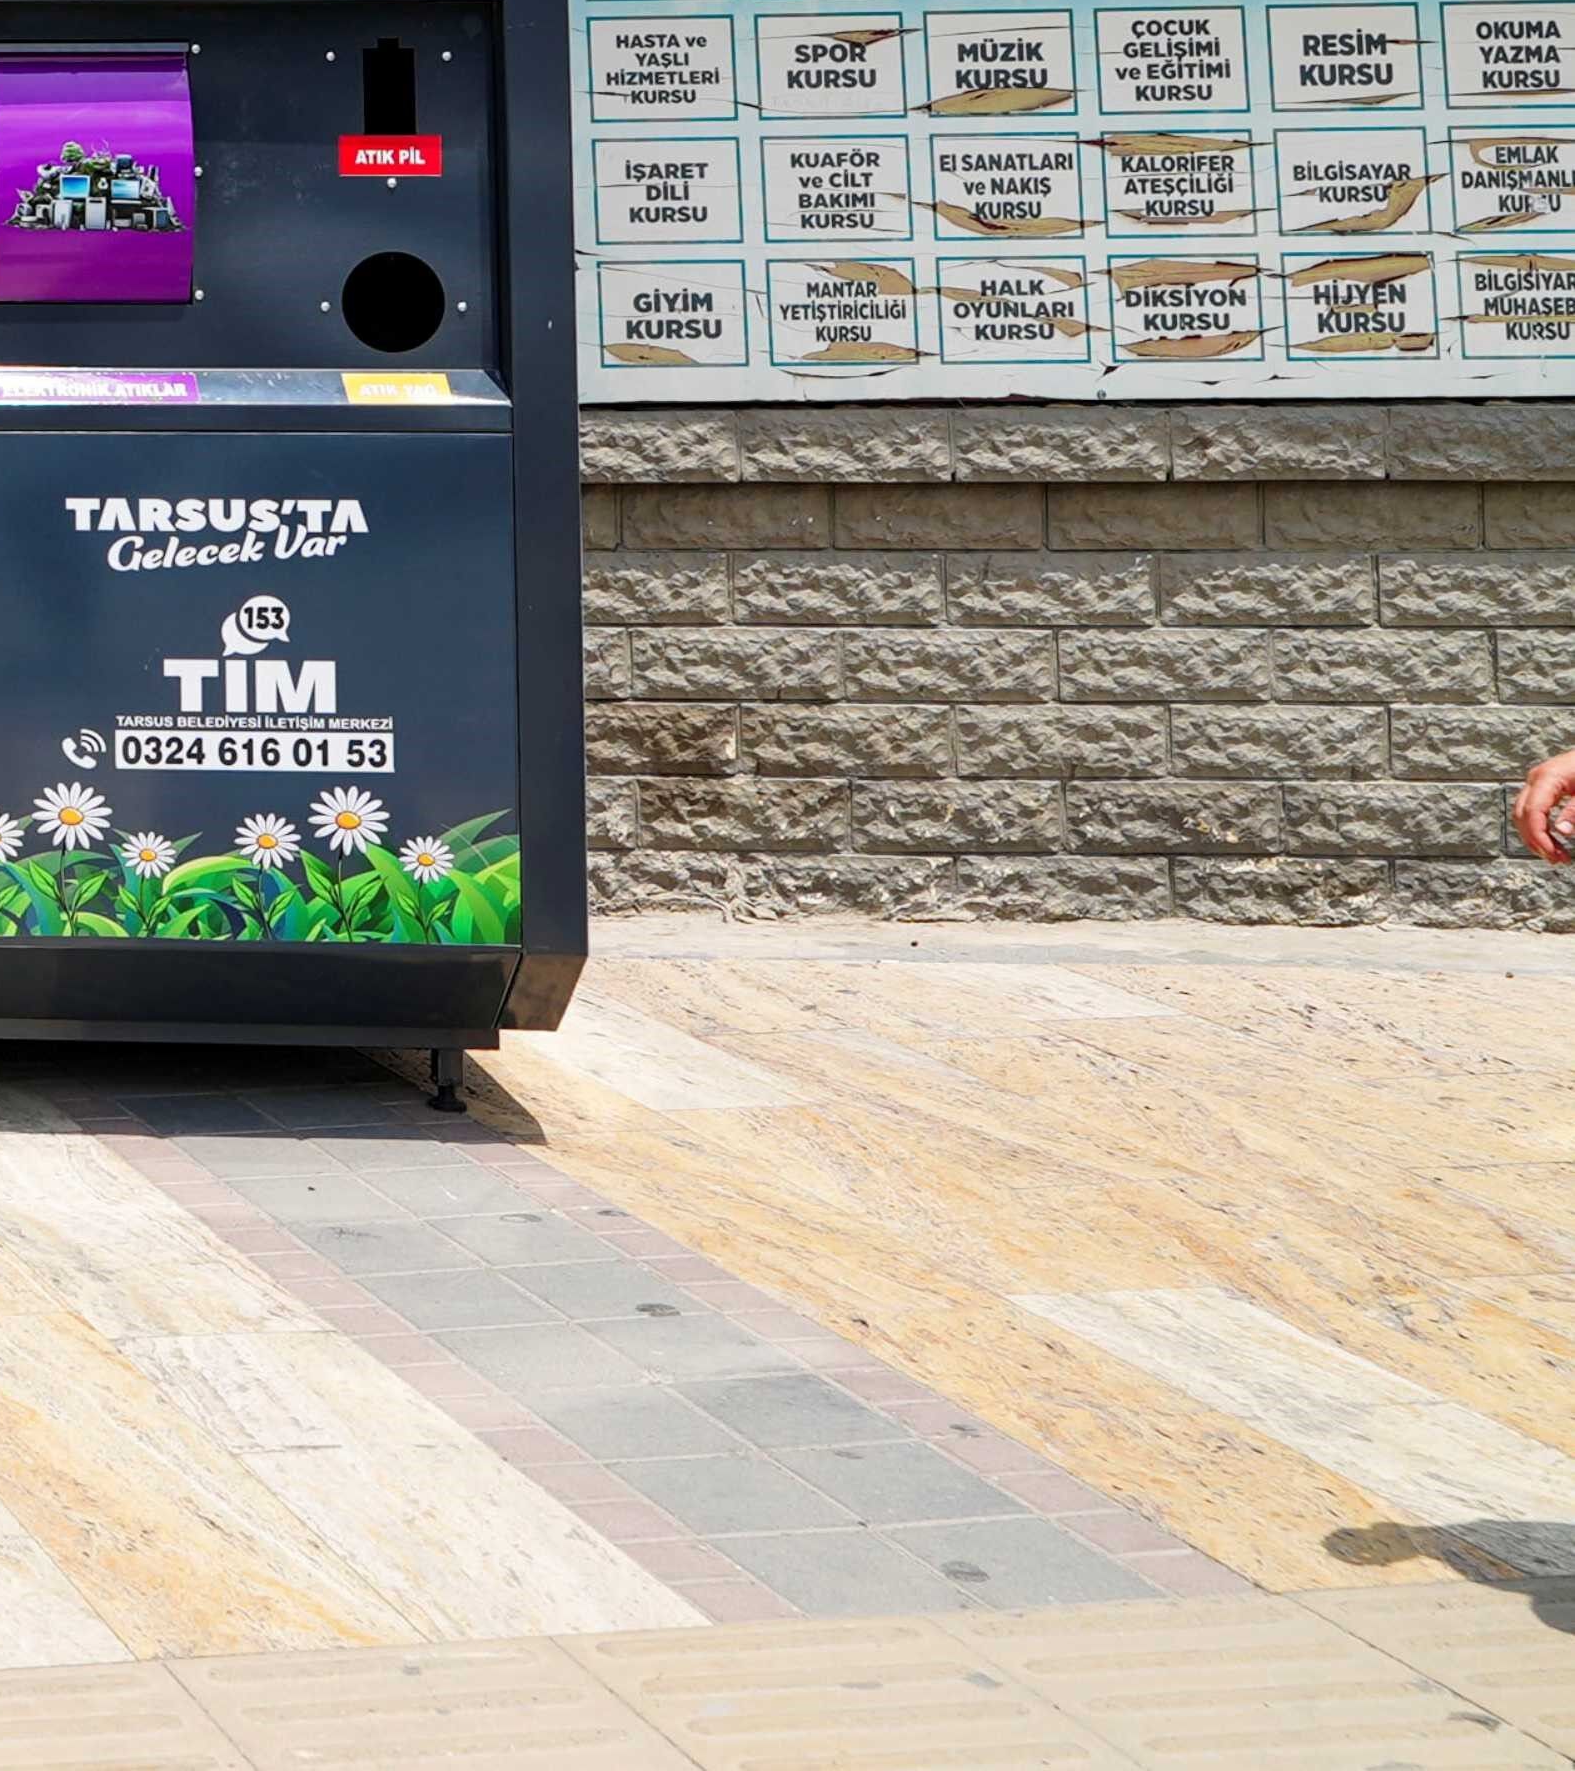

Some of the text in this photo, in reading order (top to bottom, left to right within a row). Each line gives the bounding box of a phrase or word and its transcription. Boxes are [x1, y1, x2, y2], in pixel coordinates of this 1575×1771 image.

[1130, 18, 1211, 40] ÇOCUK
[1475, 19, 1561, 40] OKUMA
[615, 32, 707, 49] HASTA ve
[957, 37, 1044, 63] MÜZİK
[1122, 37, 1221, 62] GELİŞİMİ
[1302, 28, 1388, 57] RESİM
[636, 51, 690, 70] YAŞLI
[794, 42, 867, 64] SPOR
[1478, 44, 1561, 65] YAZMA
[605, 66, 721, 86] HİZMETLERİ
[786, 67, 877, 89] KURSU
[955, 67, 1048, 90] KURSU
[1115, 58, 1232, 81] ve EĞİTİMİ
[1299, 63, 1394, 87] KURSU
[1481, 68, 1561, 89] KURSU
[630, 88, 697, 104] KURSU
[1134, 83, 1213, 103] KURSU
[355, 146, 426, 165] ATIK PİL
[790, 147, 881, 170] KUAFÖR
[961, 153, 1073, 172] SANATLARI
[1121, 151, 1235, 174] KALORİFER
[1495, 145, 1559, 164] EMLAK
[625, 160, 709, 184] İŞARET
[799, 169, 872, 188] ve CİLT
[1292, 160, 1411, 182] BİLGİSAYAR
[647, 180, 690, 202] DİLİ
[963, 177, 1052, 198] ve NAKIŞ
[1124, 173, 1234, 197] ATEŞÇİLİĞİ
[1319, 185, 1389, 203] KURSU
[798, 192, 876, 209] BAKIMI
[975, 201, 1042, 220] KURSU
[1144, 199, 1215, 217] KURSU
[628, 205, 708, 224] KURSU
[800, 212, 875, 229] KURSU
[806, 281, 877, 299] MANTAR
[980, 279, 1044, 297] HALK
[1125, 286, 1246, 308] DİKSİYON
[1312, 279, 1406, 306] HİJYEN
[633, 288, 714, 314] GİYİM
[779, 299, 907, 323] YETİŞTİRİCİLİĞİ
[953, 301, 1075, 319] OYUNLARI
[625, 318, 723, 341] KURSU
[974, 323, 1055, 341] KURSU
[1143, 312, 1231, 332] KURSU
[1317, 312, 1406, 334] KURSU
[1506, 321, 1571, 341] KURSU
[815, 325, 872, 343] KURSU
[113, 382, 188, 397] ATIKLAR
[65, 497, 370, 533] TARSUS'TA
[107, 524, 348, 572] Gelecek Var
[243, 606, 285, 630] 153
[116, 715, 394, 731] TARSUS BELEDİYESİ İLETİŞİM MERKEZİ
[121, 735, 388, 769] 0324 616 01 53
